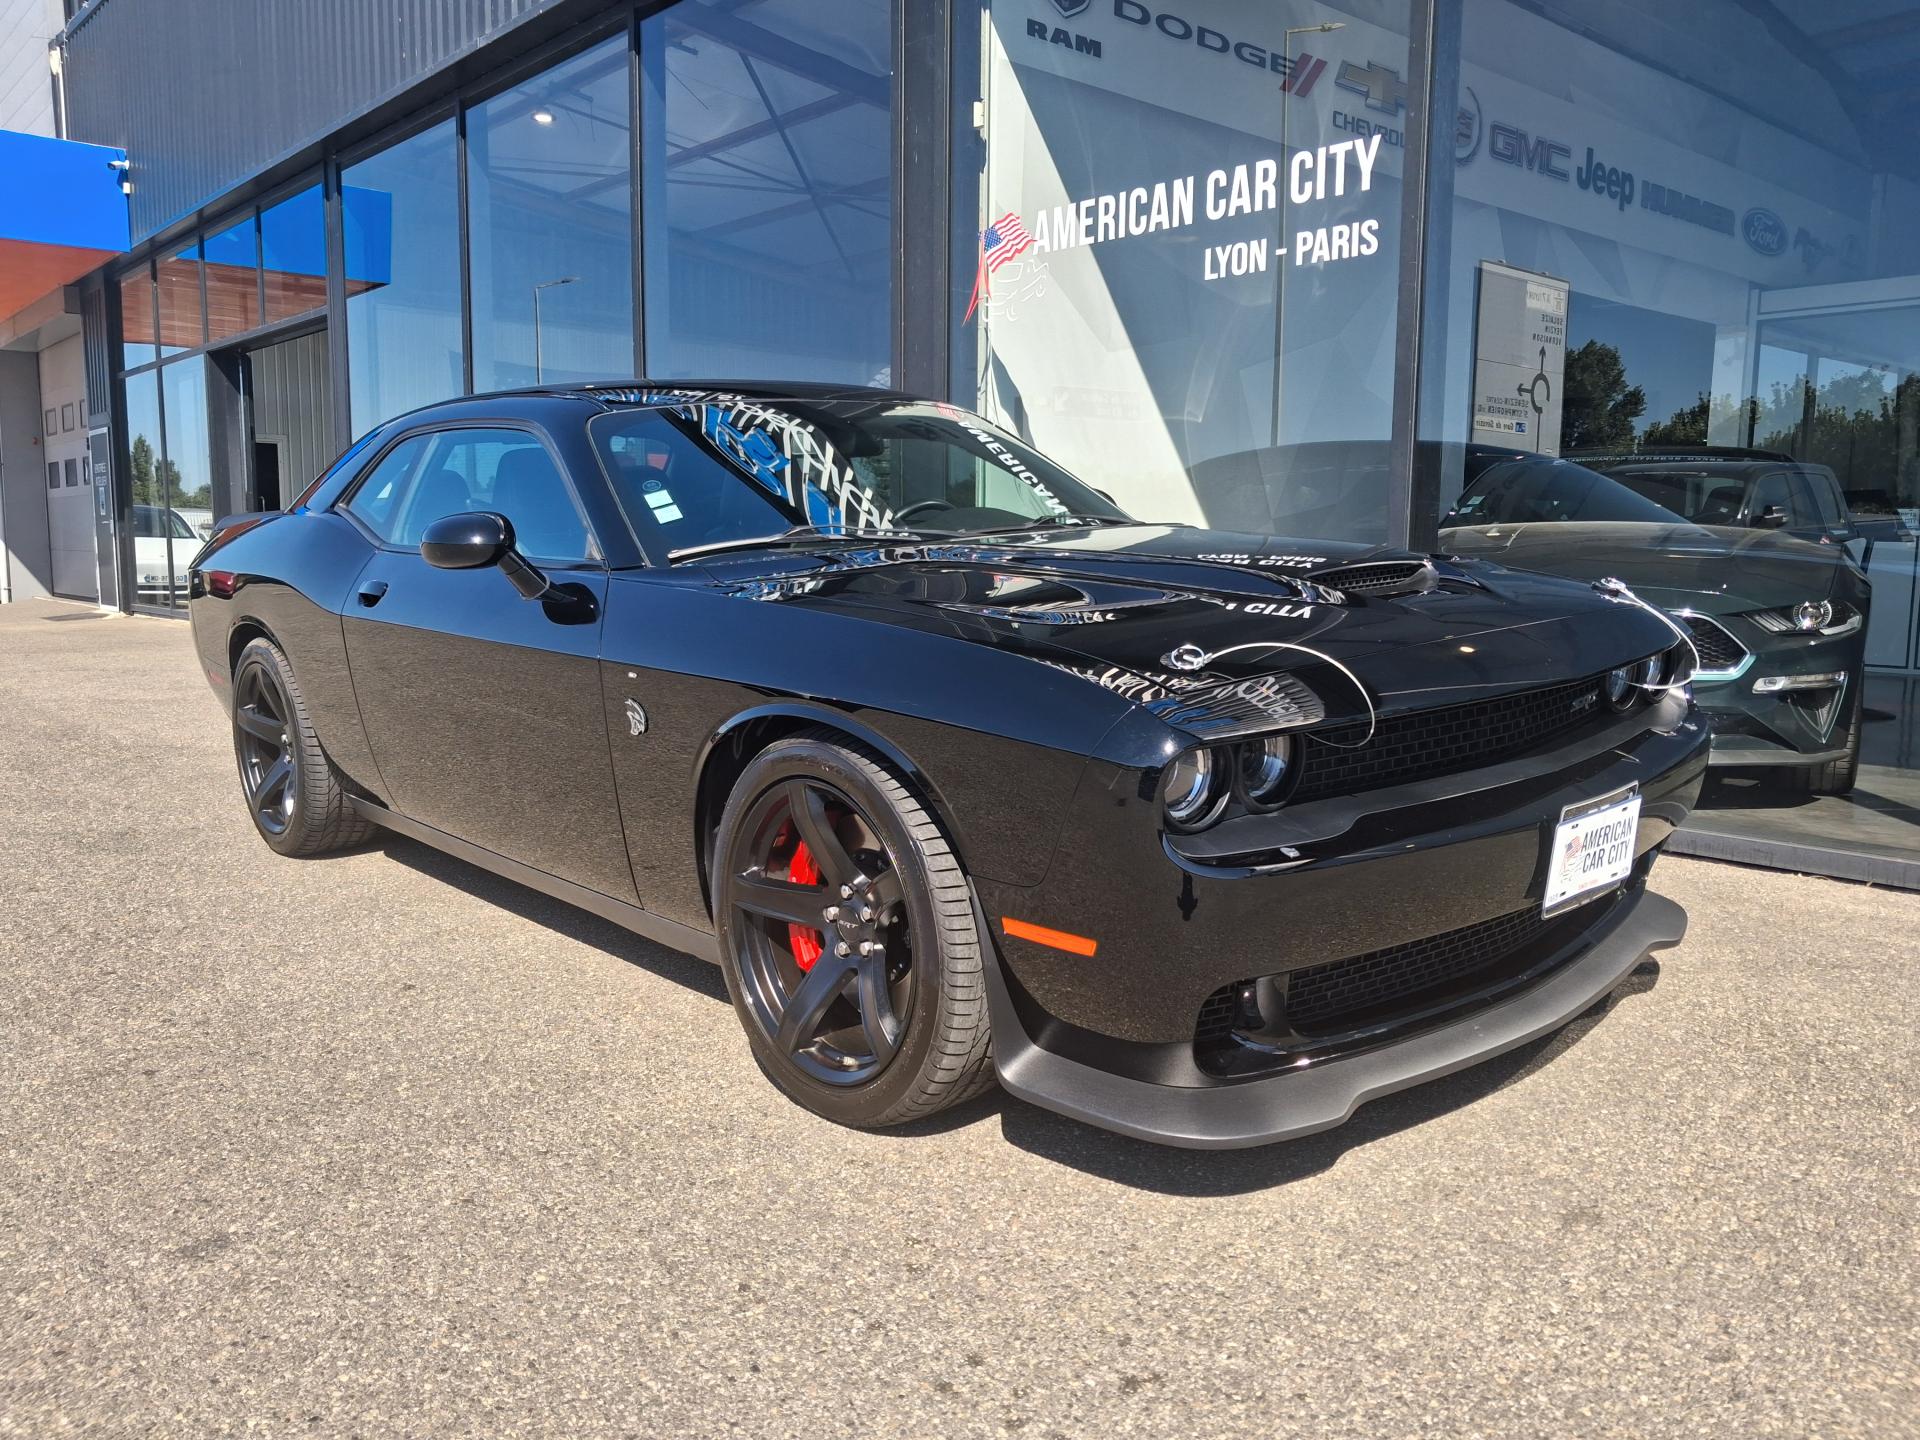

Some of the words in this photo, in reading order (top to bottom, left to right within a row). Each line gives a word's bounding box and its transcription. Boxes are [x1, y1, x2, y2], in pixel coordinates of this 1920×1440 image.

[1026, 18, 1102, 59] RAM
[1113, 0, 1300, 76] DODGE
[1332, 110, 1405, 149] CHEVROL
[1489, 119, 1572, 183] GMC
[1031, 175, 1195, 255] AMERICAN
[1206, 159, 1278, 221] CAR
[1290, 134, 1382, 205] CITY
[1576, 146, 1635, 212] Jeep
[1204, 239, 1268, 281] LYON
[1295, 219, 1380, 266] PARIS
[1747, 212, 1784, 252] Ford
[1580, 815, 1634, 854] AMERICAN
[1582, 849, 1606, 874] CAR
[1608, 839, 1631, 866] CITY
